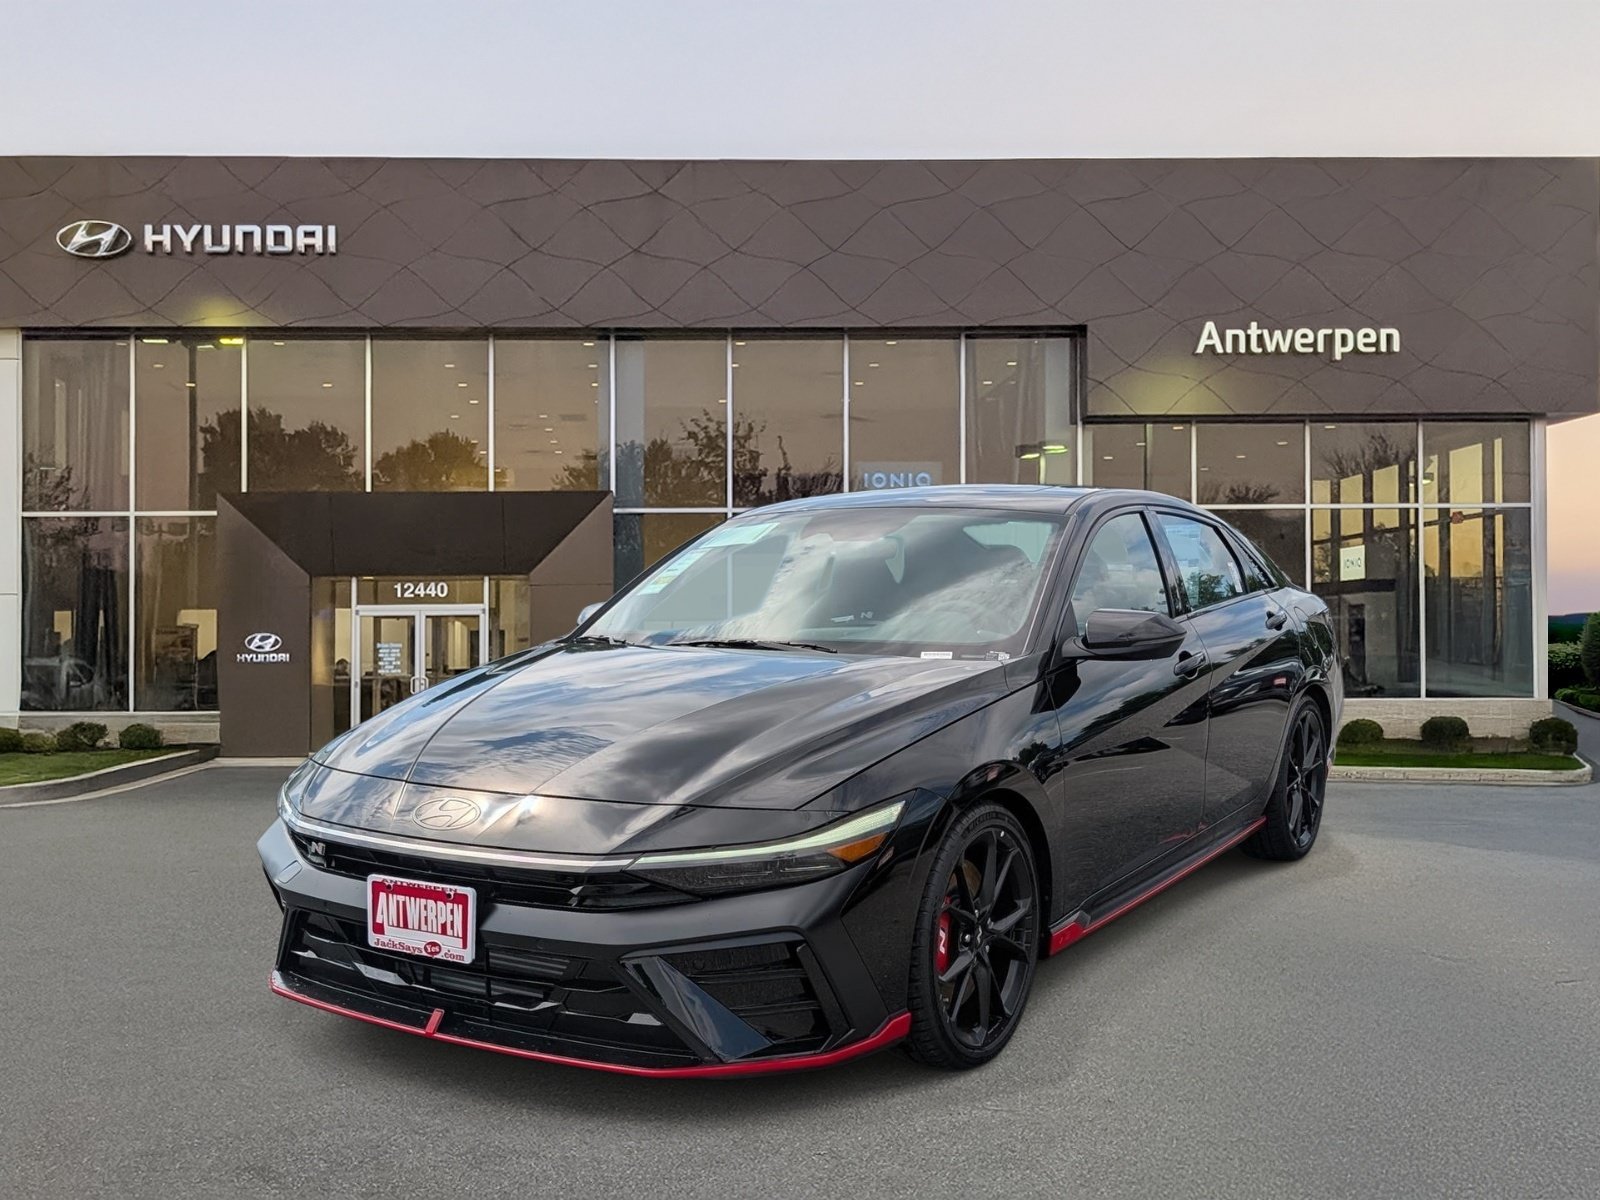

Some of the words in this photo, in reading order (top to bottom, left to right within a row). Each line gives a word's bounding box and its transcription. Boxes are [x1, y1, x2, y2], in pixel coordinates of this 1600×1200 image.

[143, 223, 337, 254] HYUNDAI
[1194, 320, 1401, 361] Antwerpen
[393, 581, 449, 598] 12440
[236, 653, 290, 663] HYUNDAI
[375, 891, 463, 939] ANTWERPEN
